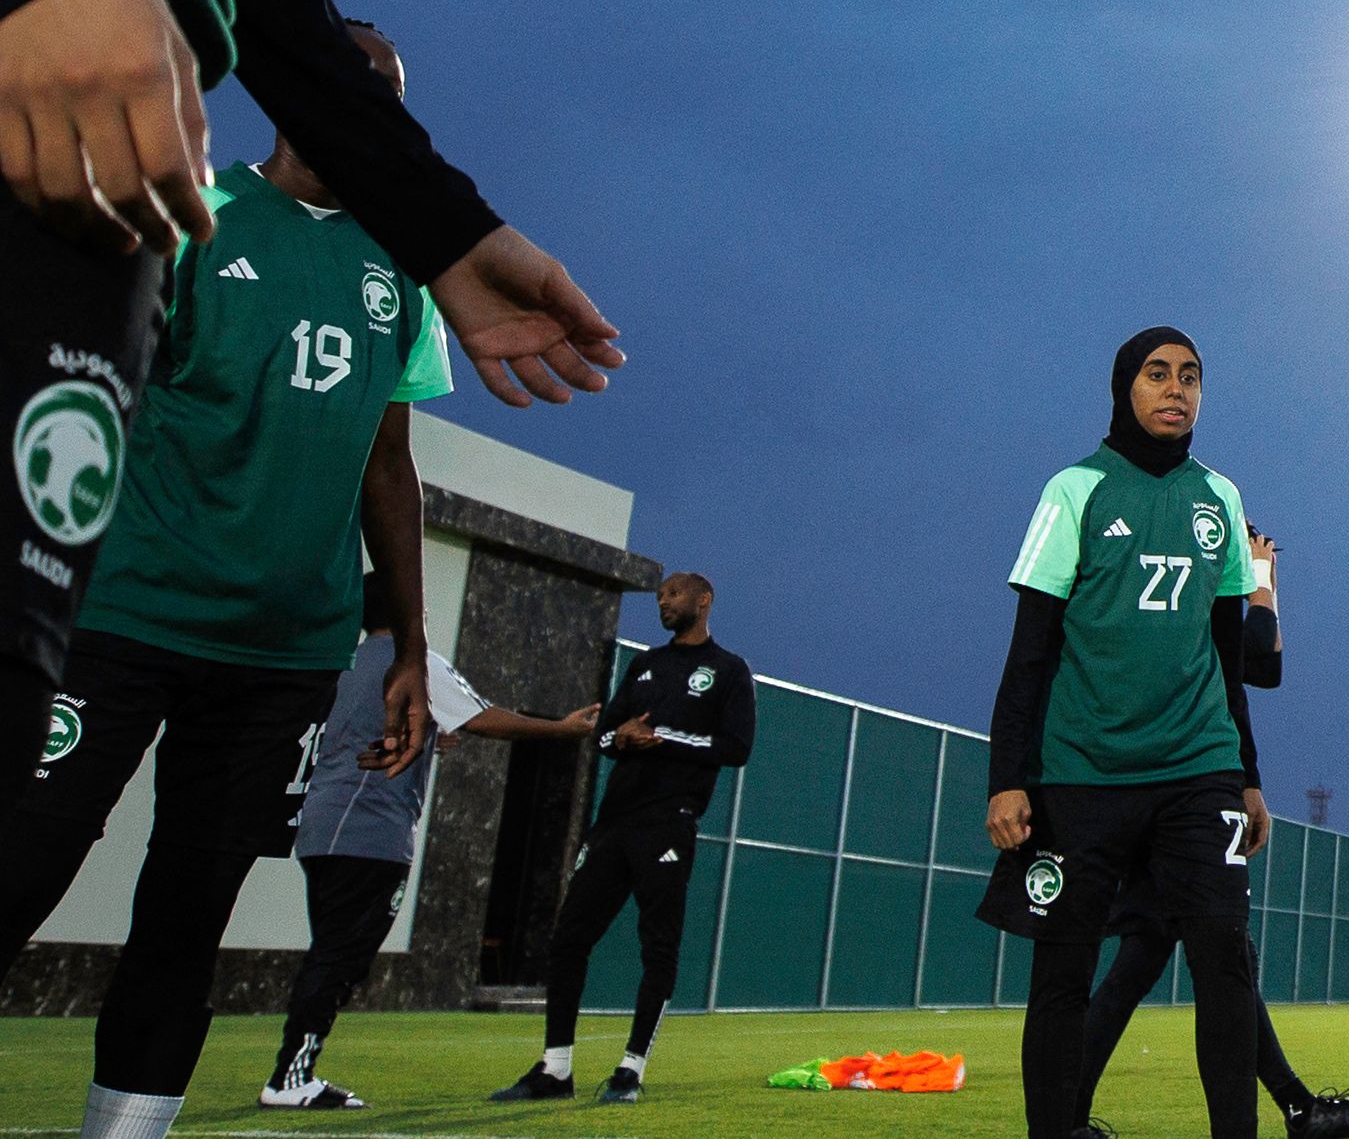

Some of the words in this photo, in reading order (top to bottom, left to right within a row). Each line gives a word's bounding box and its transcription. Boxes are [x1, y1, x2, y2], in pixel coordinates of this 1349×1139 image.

[368, 322, 391, 335] SAUDI
[291, 319, 352, 393] 19
[20, 539, 74, 590] SAUDI
[1139, 554, 1193, 611] 27
